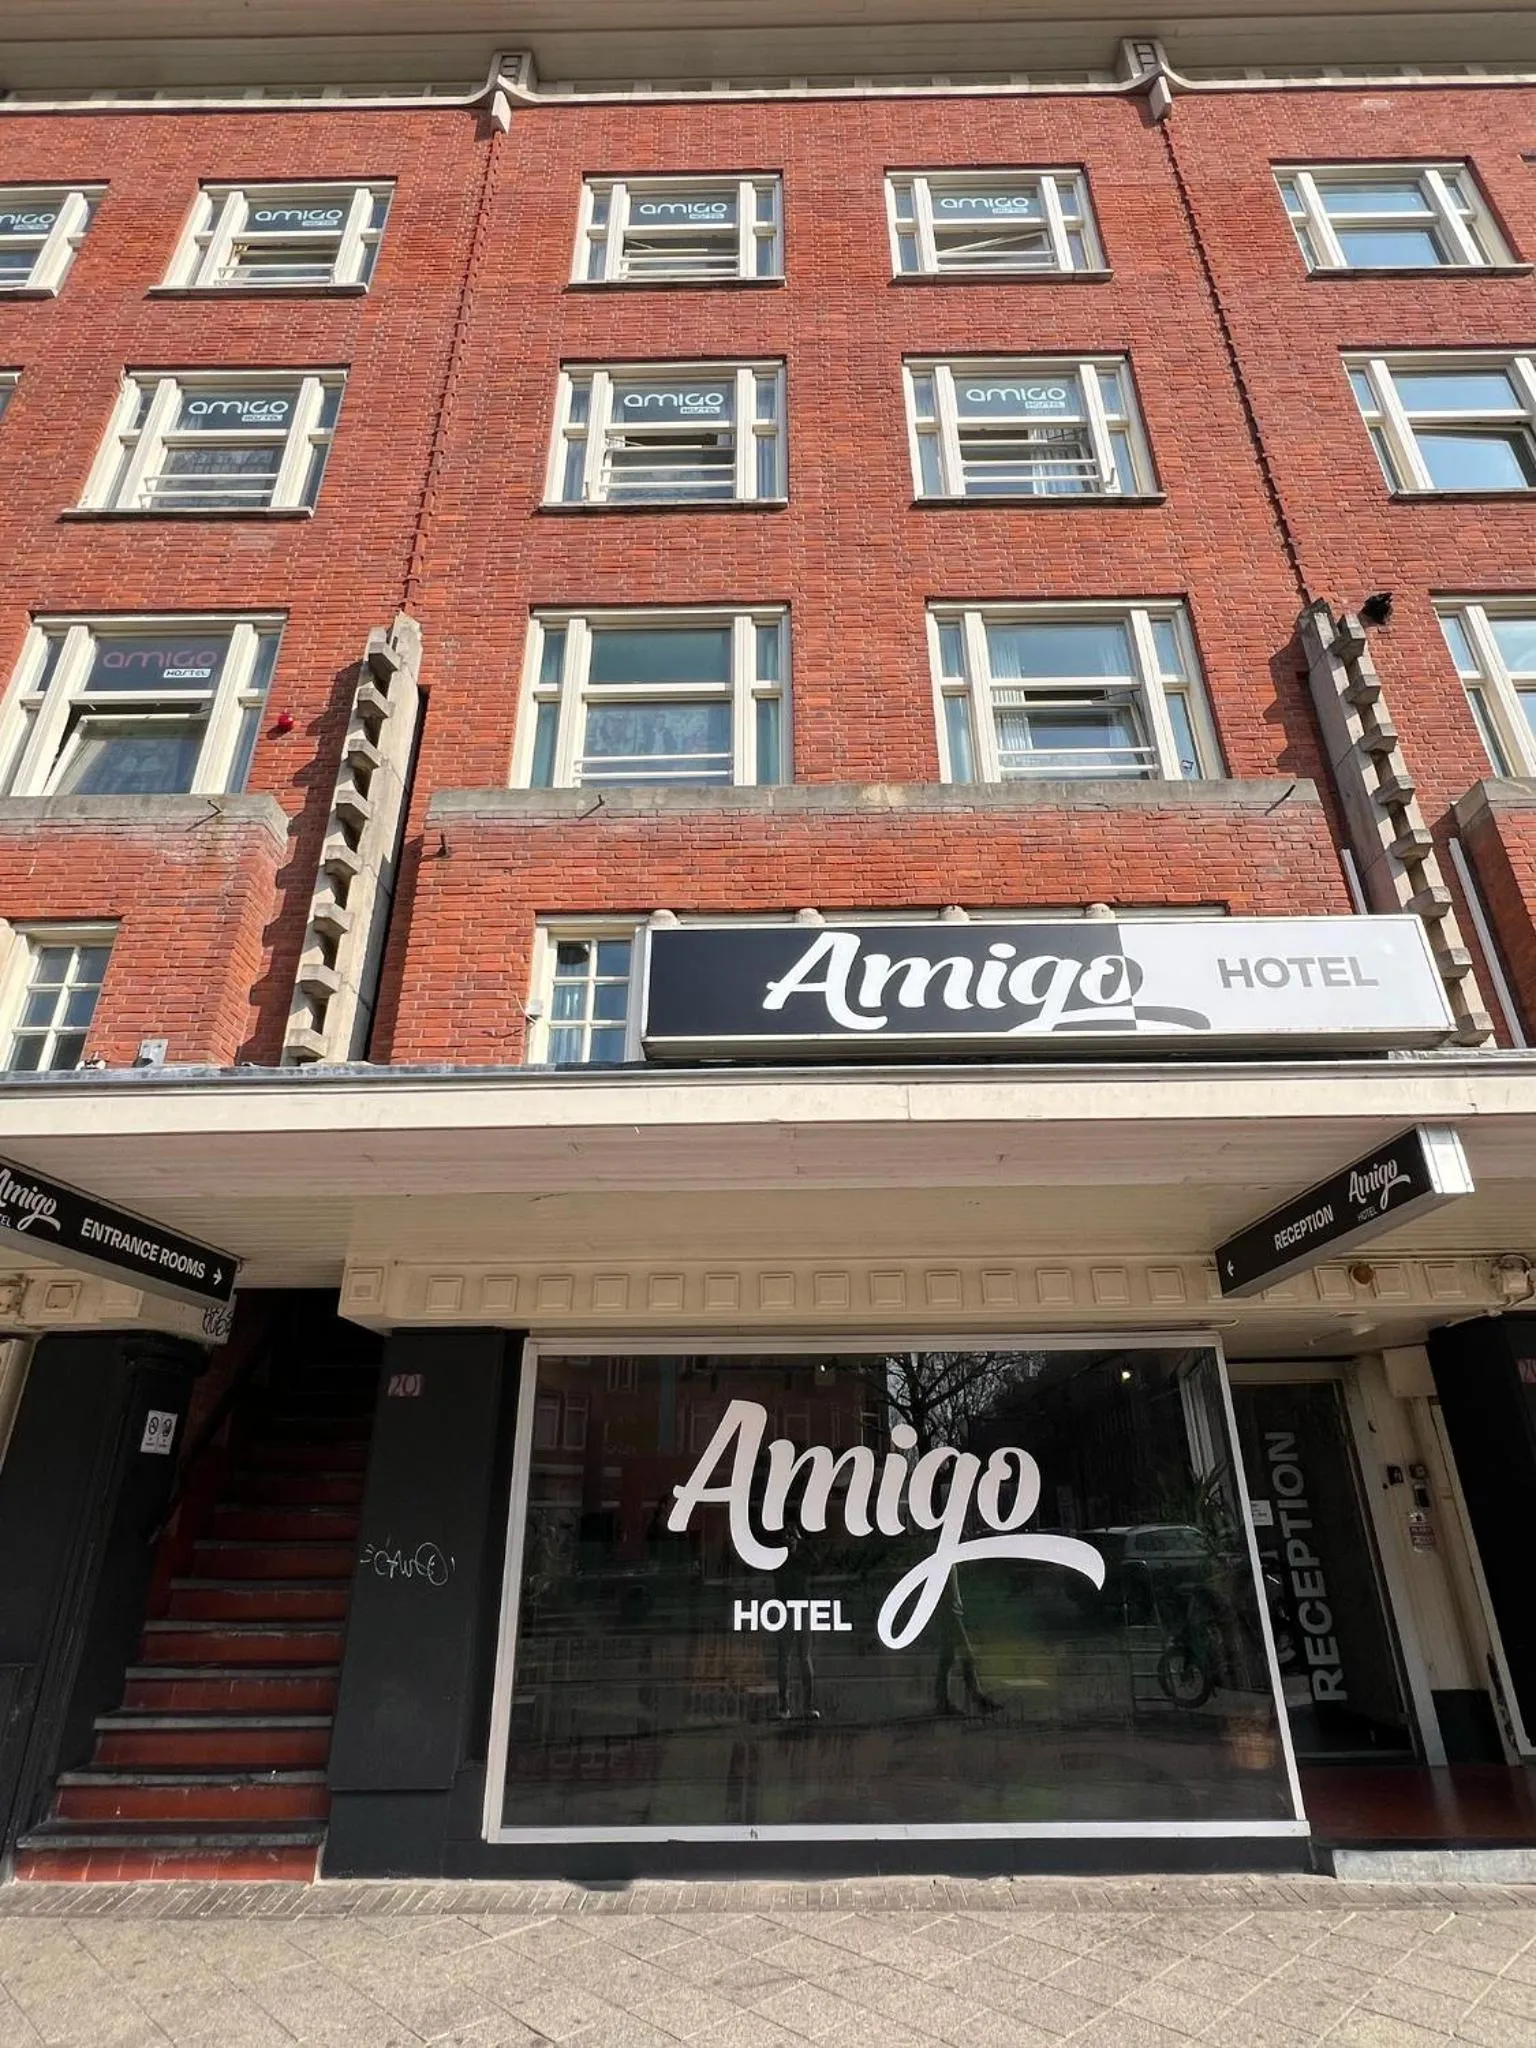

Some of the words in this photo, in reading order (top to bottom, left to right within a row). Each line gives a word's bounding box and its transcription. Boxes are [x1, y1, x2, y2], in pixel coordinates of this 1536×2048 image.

[762, 931, 1211, 1033] Amigo
[1217, 957, 1380, 989] HOTEL
[1348, 1159, 1411, 1210] Amigo
[1274, 1204, 1335, 1251] RECEPTION
[1357, 1206, 1379, 1222] HOTEL
[81, 1217, 160, 1262] ENTRANCE
[159, 1247, 206, 1279] ROOMS
[667, 1399, 1106, 1650] Amigo
[1265, 1431, 1348, 1701] RECEPTION
[733, 1599, 853, 1632] HOTEL
